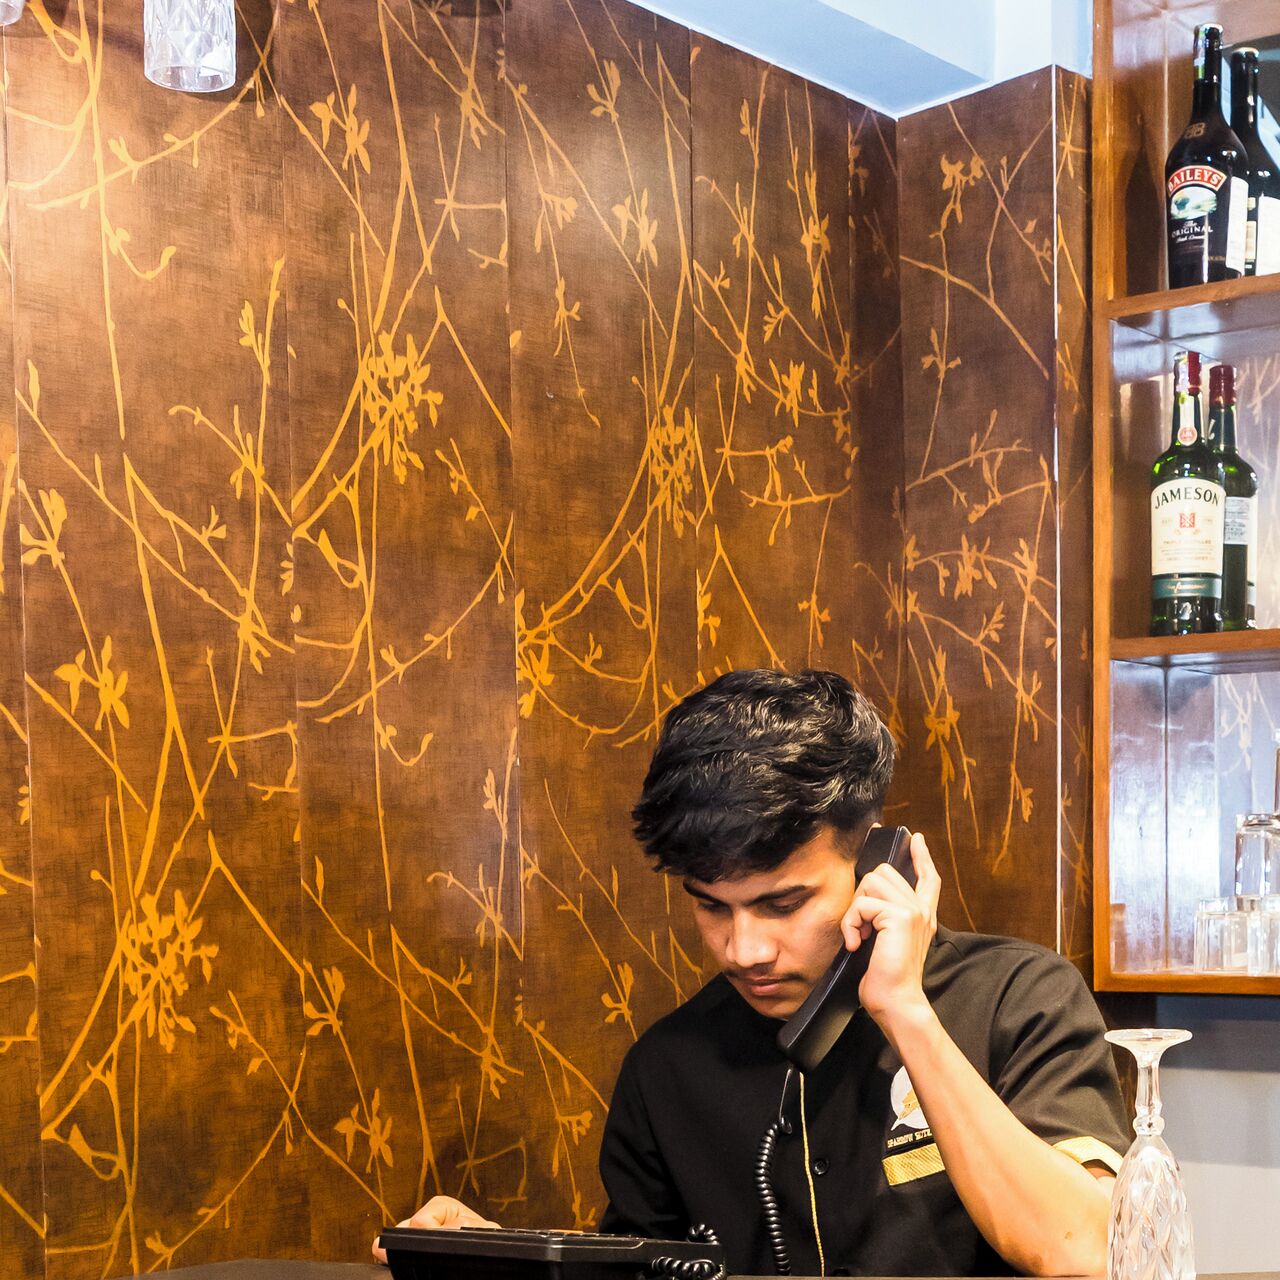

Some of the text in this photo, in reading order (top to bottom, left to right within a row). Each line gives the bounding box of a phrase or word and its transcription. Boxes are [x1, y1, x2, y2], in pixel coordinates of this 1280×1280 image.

[1168, 167, 1222, 192] BAILEYS
[1171, 225, 1214, 238] ORIGINAL
[1154, 487, 1221, 510] JAMESON
